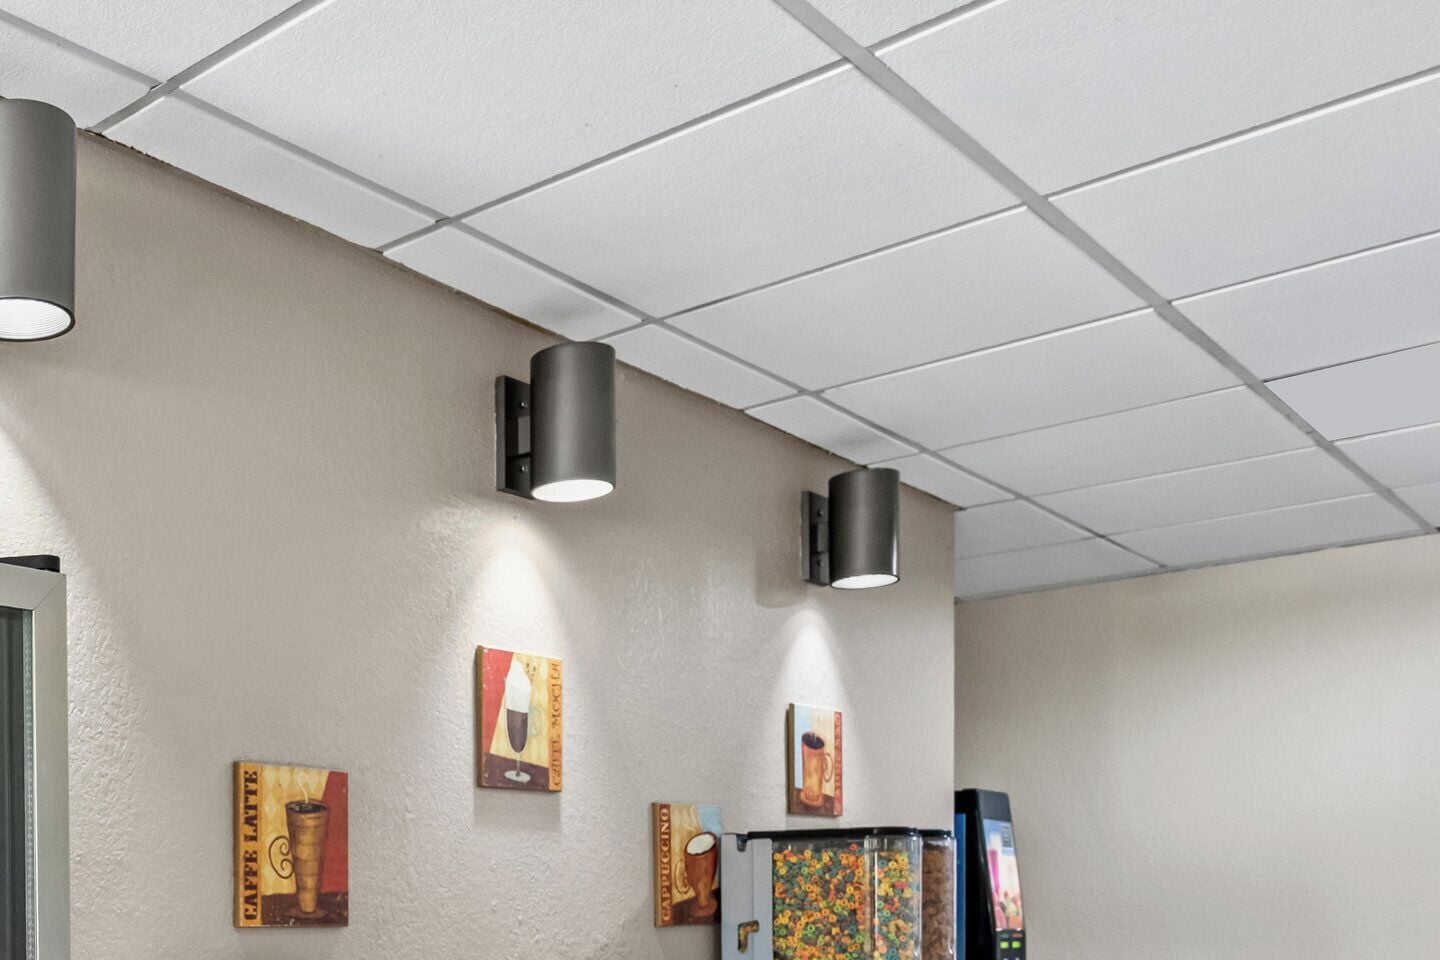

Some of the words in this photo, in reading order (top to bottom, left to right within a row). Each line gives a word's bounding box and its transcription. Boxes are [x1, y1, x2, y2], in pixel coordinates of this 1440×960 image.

[243, 770, 258, 842] LATTE
[243, 851, 258, 920] CAFFE
[660, 807, 672, 921] CAPPUCCINO
